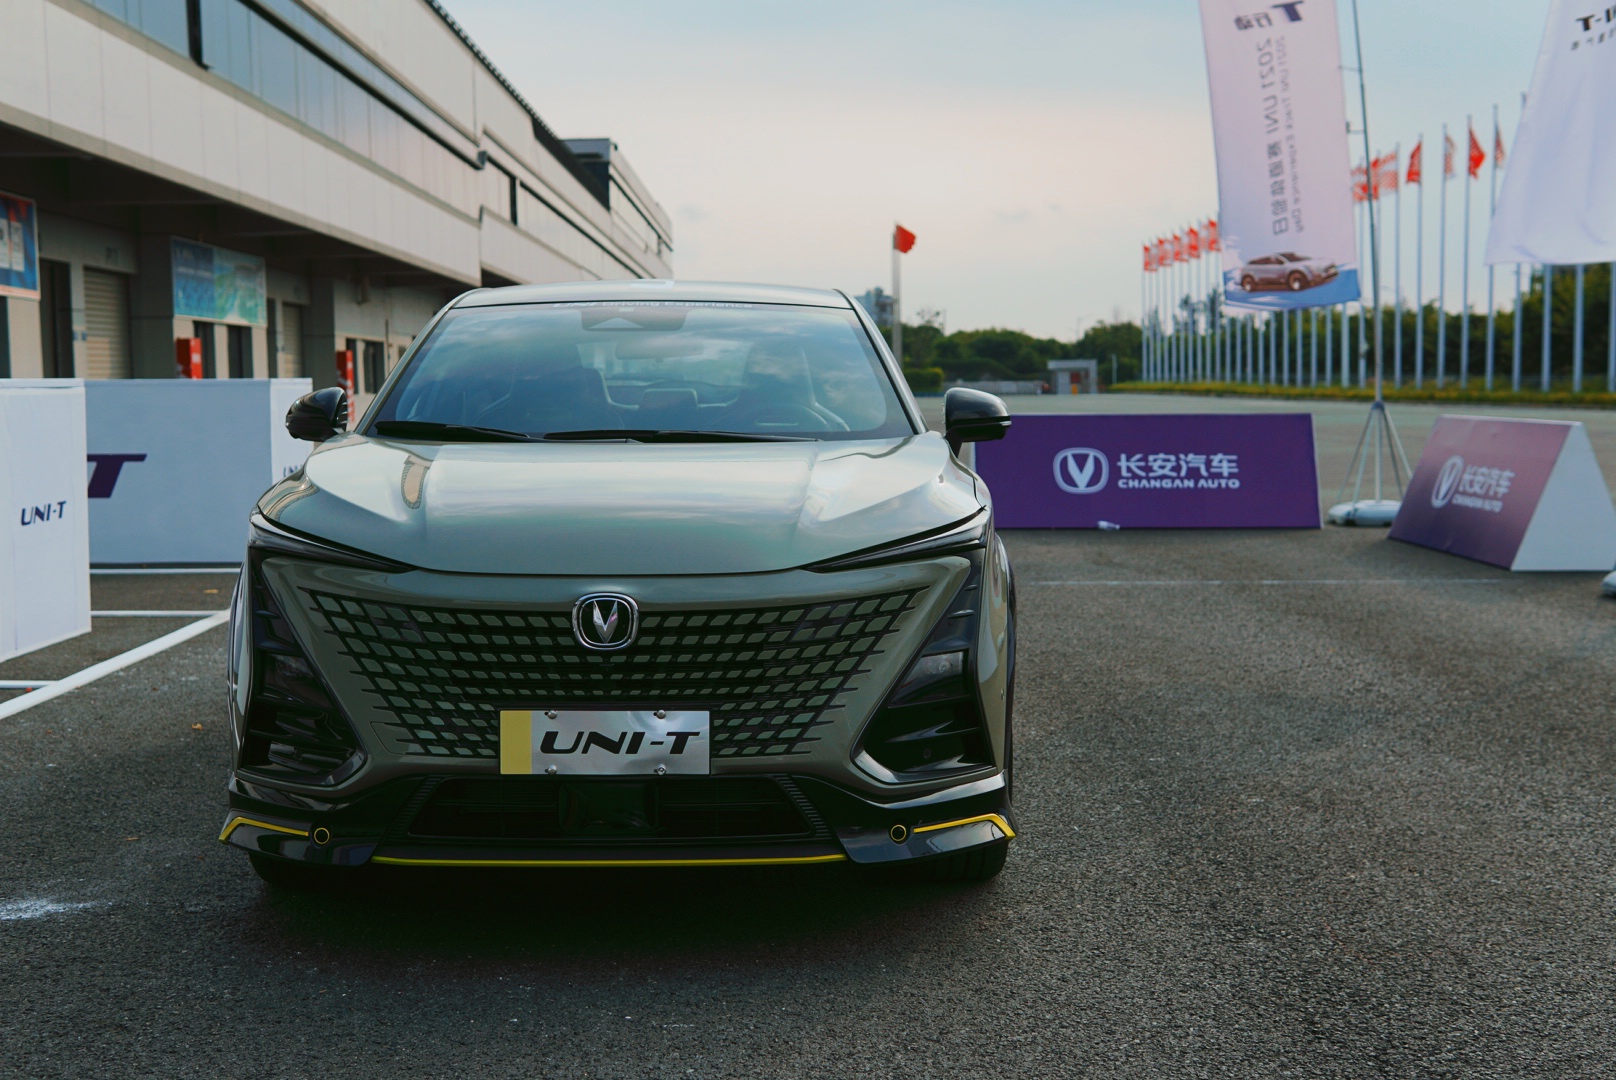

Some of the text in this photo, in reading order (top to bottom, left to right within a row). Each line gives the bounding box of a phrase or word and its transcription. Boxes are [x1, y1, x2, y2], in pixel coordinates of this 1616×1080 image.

[1117, 453, 1239, 477] 长安汽车
[1118, 479, 1240, 489] CHANGAN AUTO
[1458, 465, 1516, 498] 长安汽车
[21, 500, 67, 526] UNI-T
[540, 731, 700, 755] UNI-T
